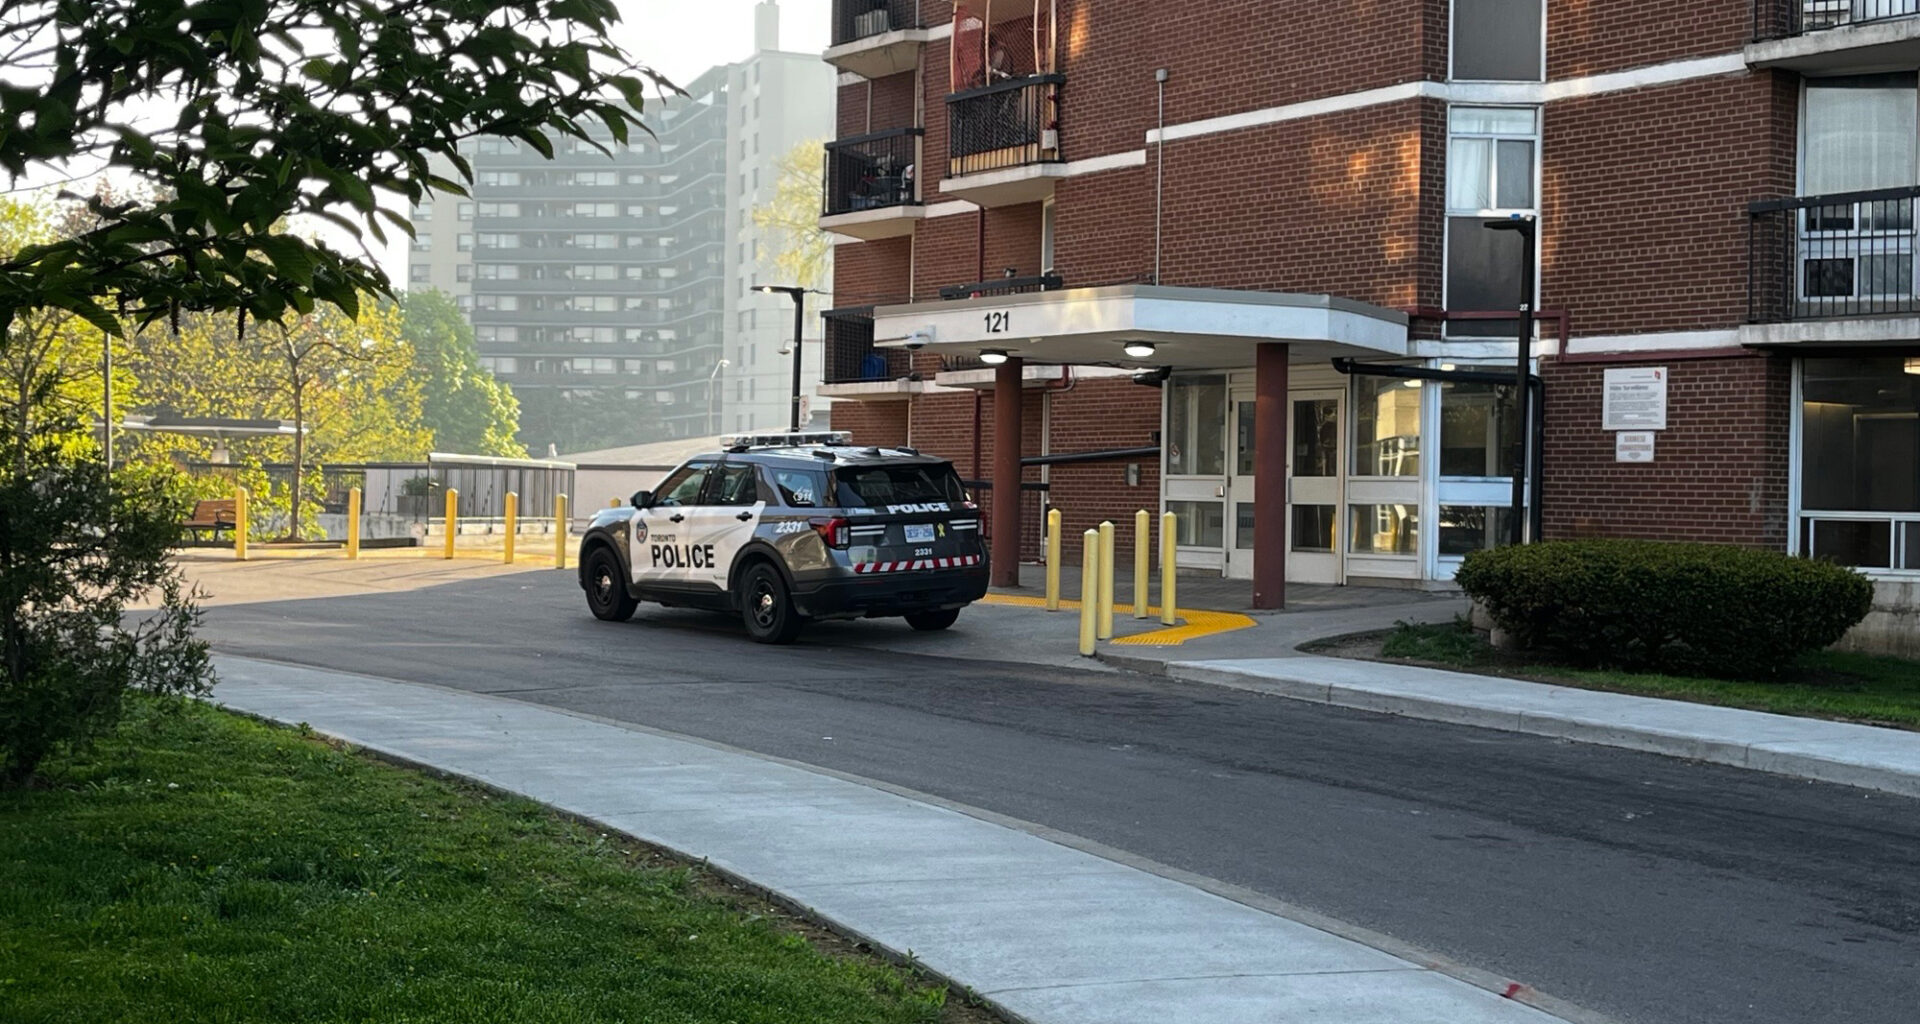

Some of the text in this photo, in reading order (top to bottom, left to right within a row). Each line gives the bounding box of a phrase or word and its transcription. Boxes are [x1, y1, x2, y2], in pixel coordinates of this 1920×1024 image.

[984, 311, 1009, 333] 121
[886, 502, 951, 515] POLICE
[776, 521, 803, 534] 2331
[651, 534, 677, 542] TORONTO
[651, 544, 715, 568] POLICE
[915, 548, 933, 557] 2331
